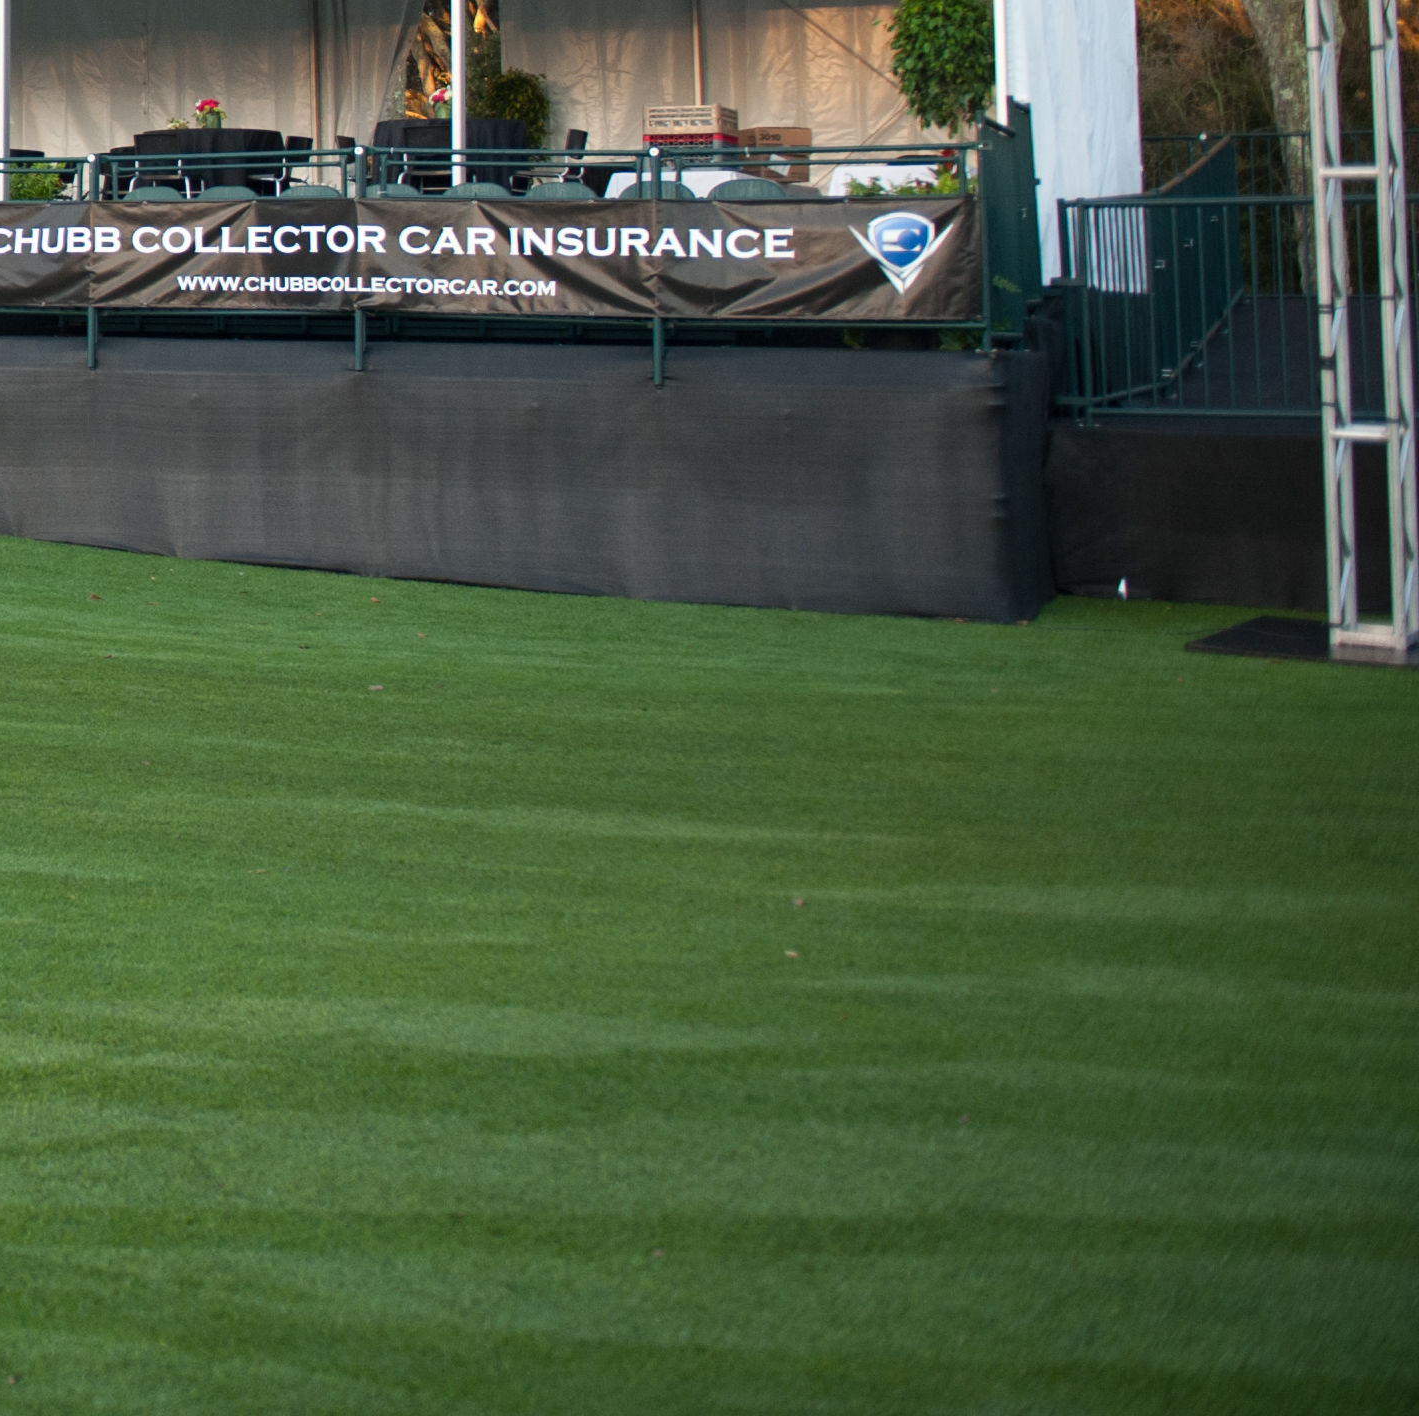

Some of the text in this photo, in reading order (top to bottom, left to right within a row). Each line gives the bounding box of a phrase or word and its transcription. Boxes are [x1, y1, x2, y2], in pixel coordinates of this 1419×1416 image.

[131, 225, 386, 254] COLLECTOR
[398, 225, 496, 256] CAR
[508, 226, 796, 259] INSURANCE
[177, 275, 556, 297] WWW.CHUBBCOLLECTORCAR.COM
